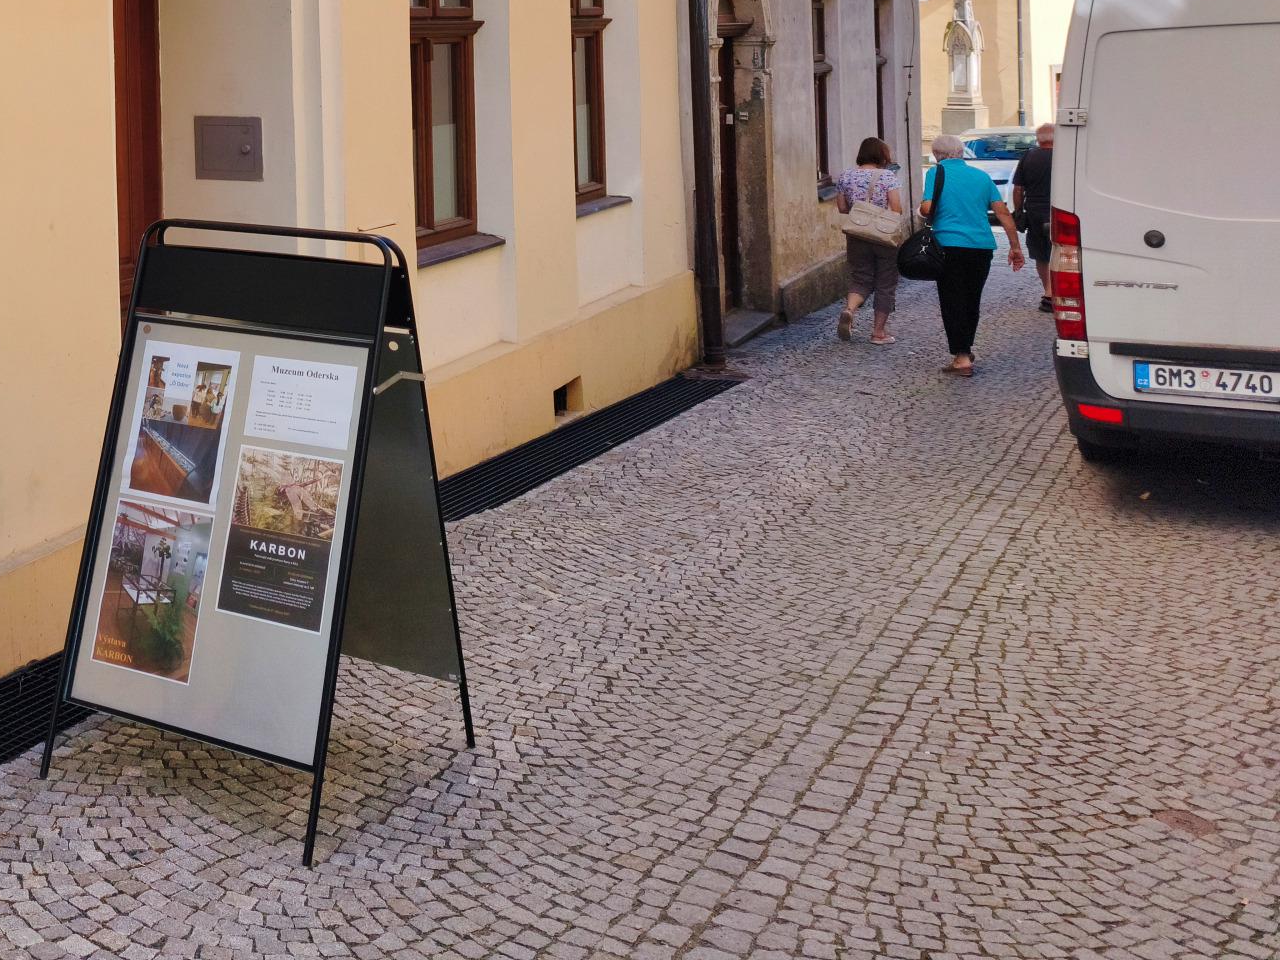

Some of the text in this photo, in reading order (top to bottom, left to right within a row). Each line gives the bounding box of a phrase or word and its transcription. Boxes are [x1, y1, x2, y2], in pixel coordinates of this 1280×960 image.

[1093, 280, 1179, 291] SPRINTER
[272, 365, 339, 381] Muzeum Oderska
[1137, 367, 1273, 394] CZ 6M3 4740
[249, 539, 306, 560] KARBON
[96, 647, 133, 663] KARBON
